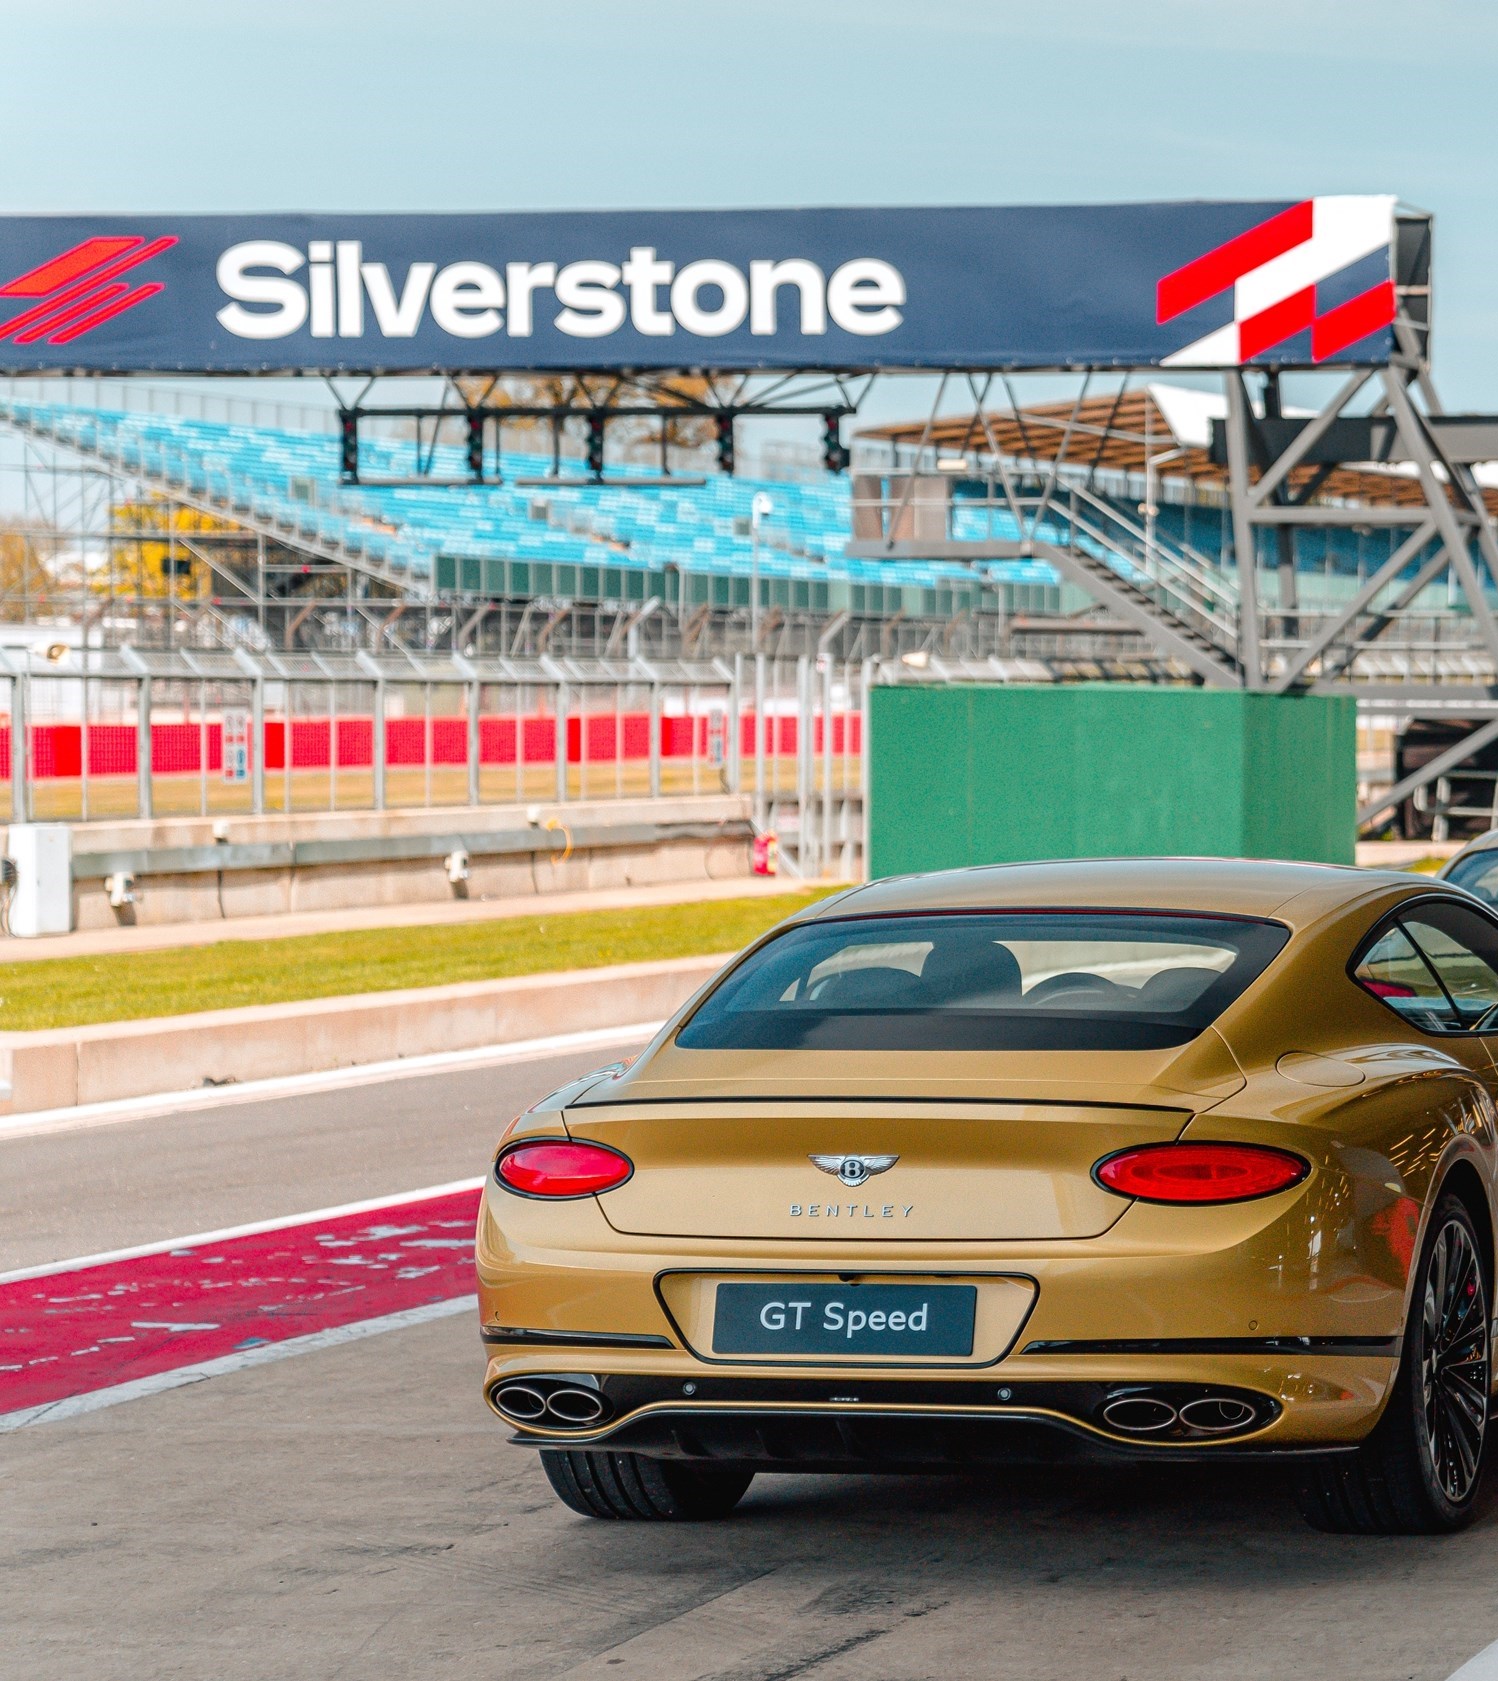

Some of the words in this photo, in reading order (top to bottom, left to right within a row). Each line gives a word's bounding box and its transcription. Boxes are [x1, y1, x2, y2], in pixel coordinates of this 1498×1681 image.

[216, 240, 906, 338] Silverstone
[789, 1204, 914, 1218] BENTLEY
[760, 1302, 811, 1330] GT
[823, 1302, 928, 1338] Speed
